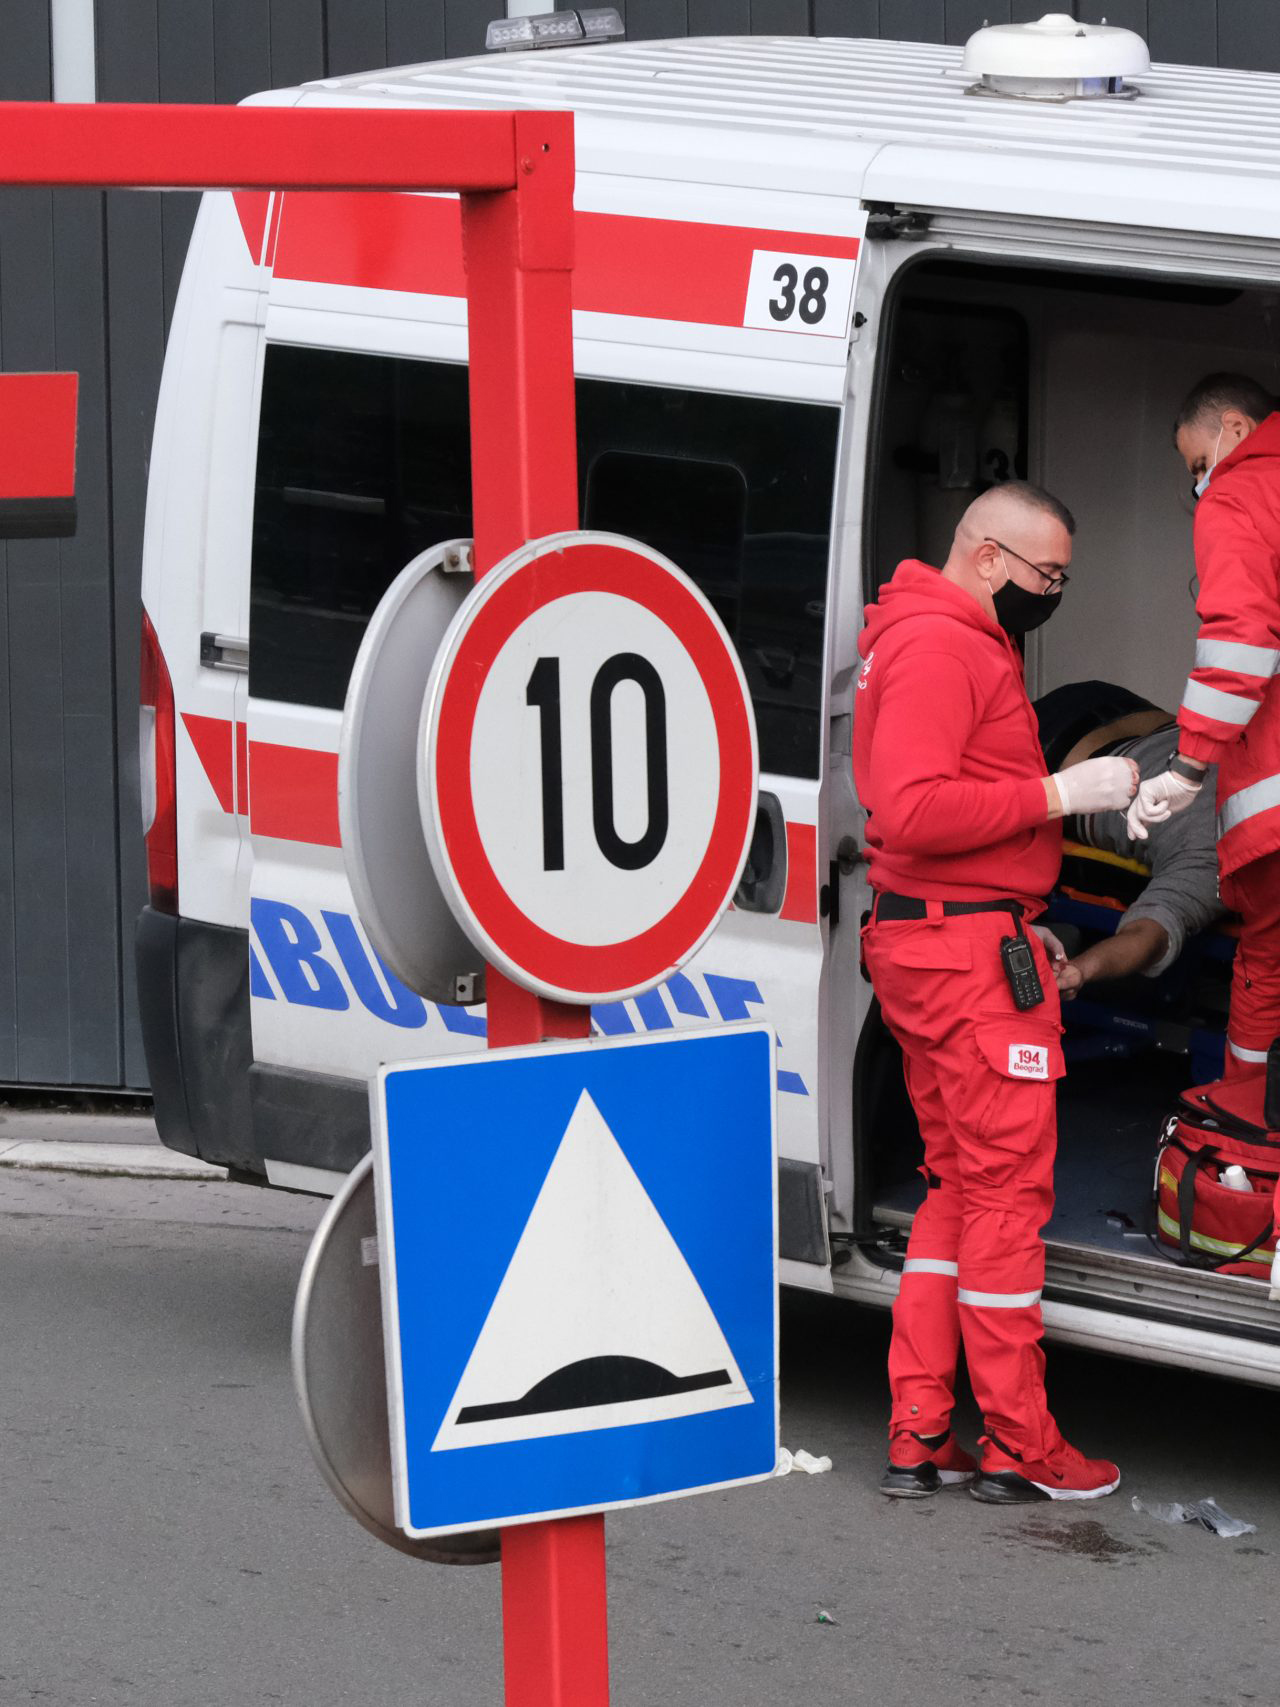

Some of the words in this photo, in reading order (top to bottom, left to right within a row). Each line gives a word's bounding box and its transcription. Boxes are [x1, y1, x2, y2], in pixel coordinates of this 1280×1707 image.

[768, 262, 830, 325] 38
[526, 652, 669, 871] 10
[1013, 1062, 1044, 1074] Beograd
[1018, 1049, 1041, 1066] 194
